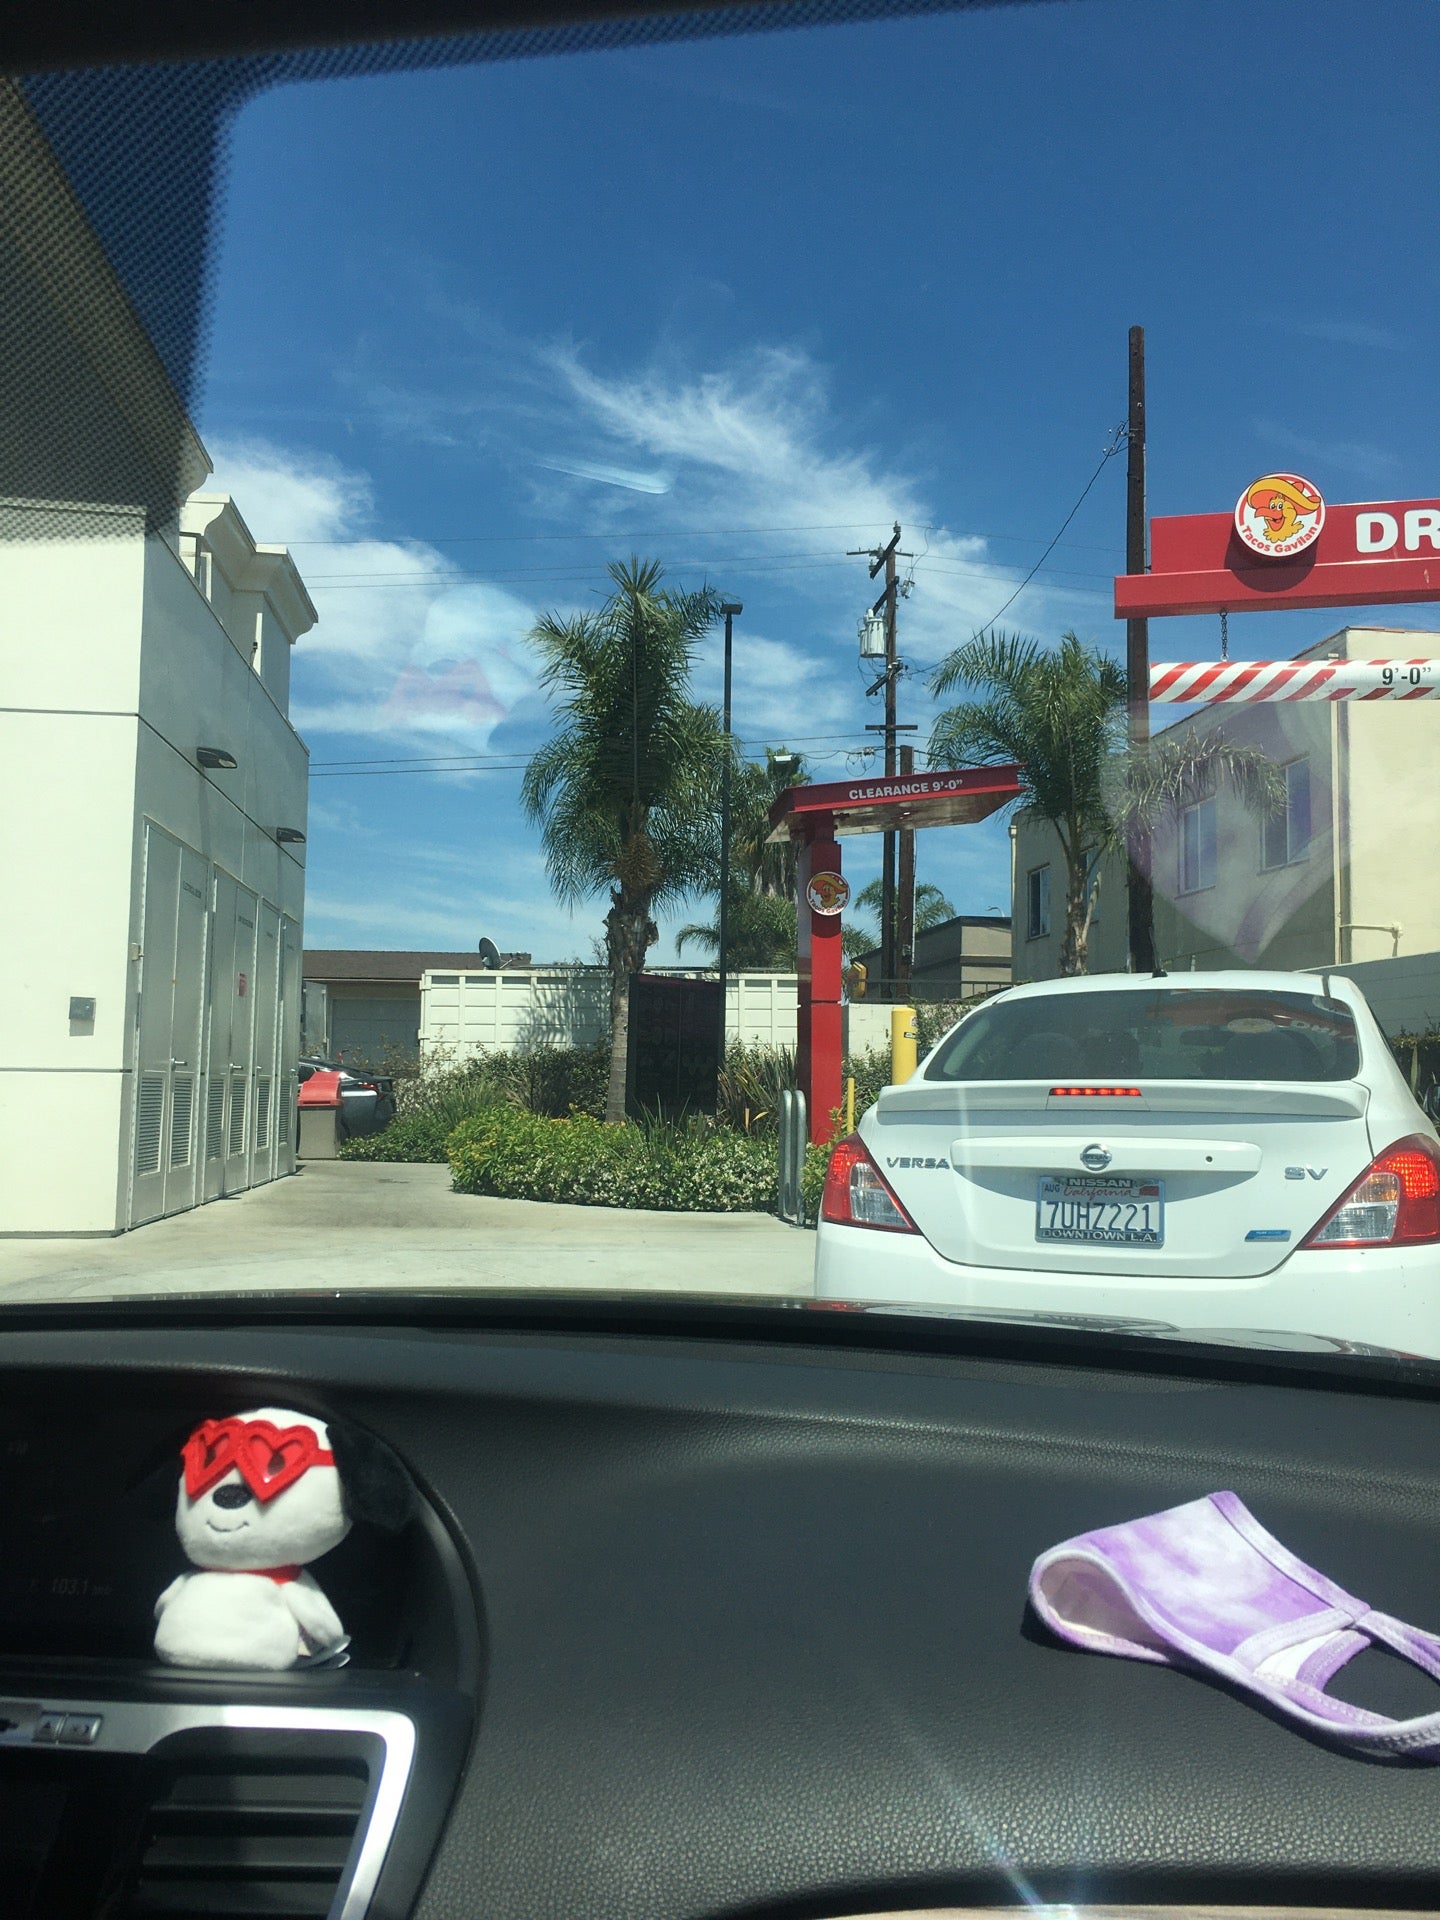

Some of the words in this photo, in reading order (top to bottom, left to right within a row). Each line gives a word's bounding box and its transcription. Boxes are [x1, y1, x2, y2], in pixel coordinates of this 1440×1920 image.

[1356, 509, 1440, 553] DR
[1242, 525, 1271, 552] Tacos
[1274, 526, 1318, 553] Gavilan
[849, 782, 929, 800] CLEARANCE
[886, 1157, 950, 1170] VERSA
[1284, 1166, 1329, 1180] SV
[1045, 1184, 1061, 1193] AUG
[1068, 1178, 1132, 1188] NISSAN
[1063, 1186, 1136, 1201] California
[1046, 1201, 1155, 1232] 7UHZ221
[1042, 1229, 1126, 1241] DOWNTOWN
